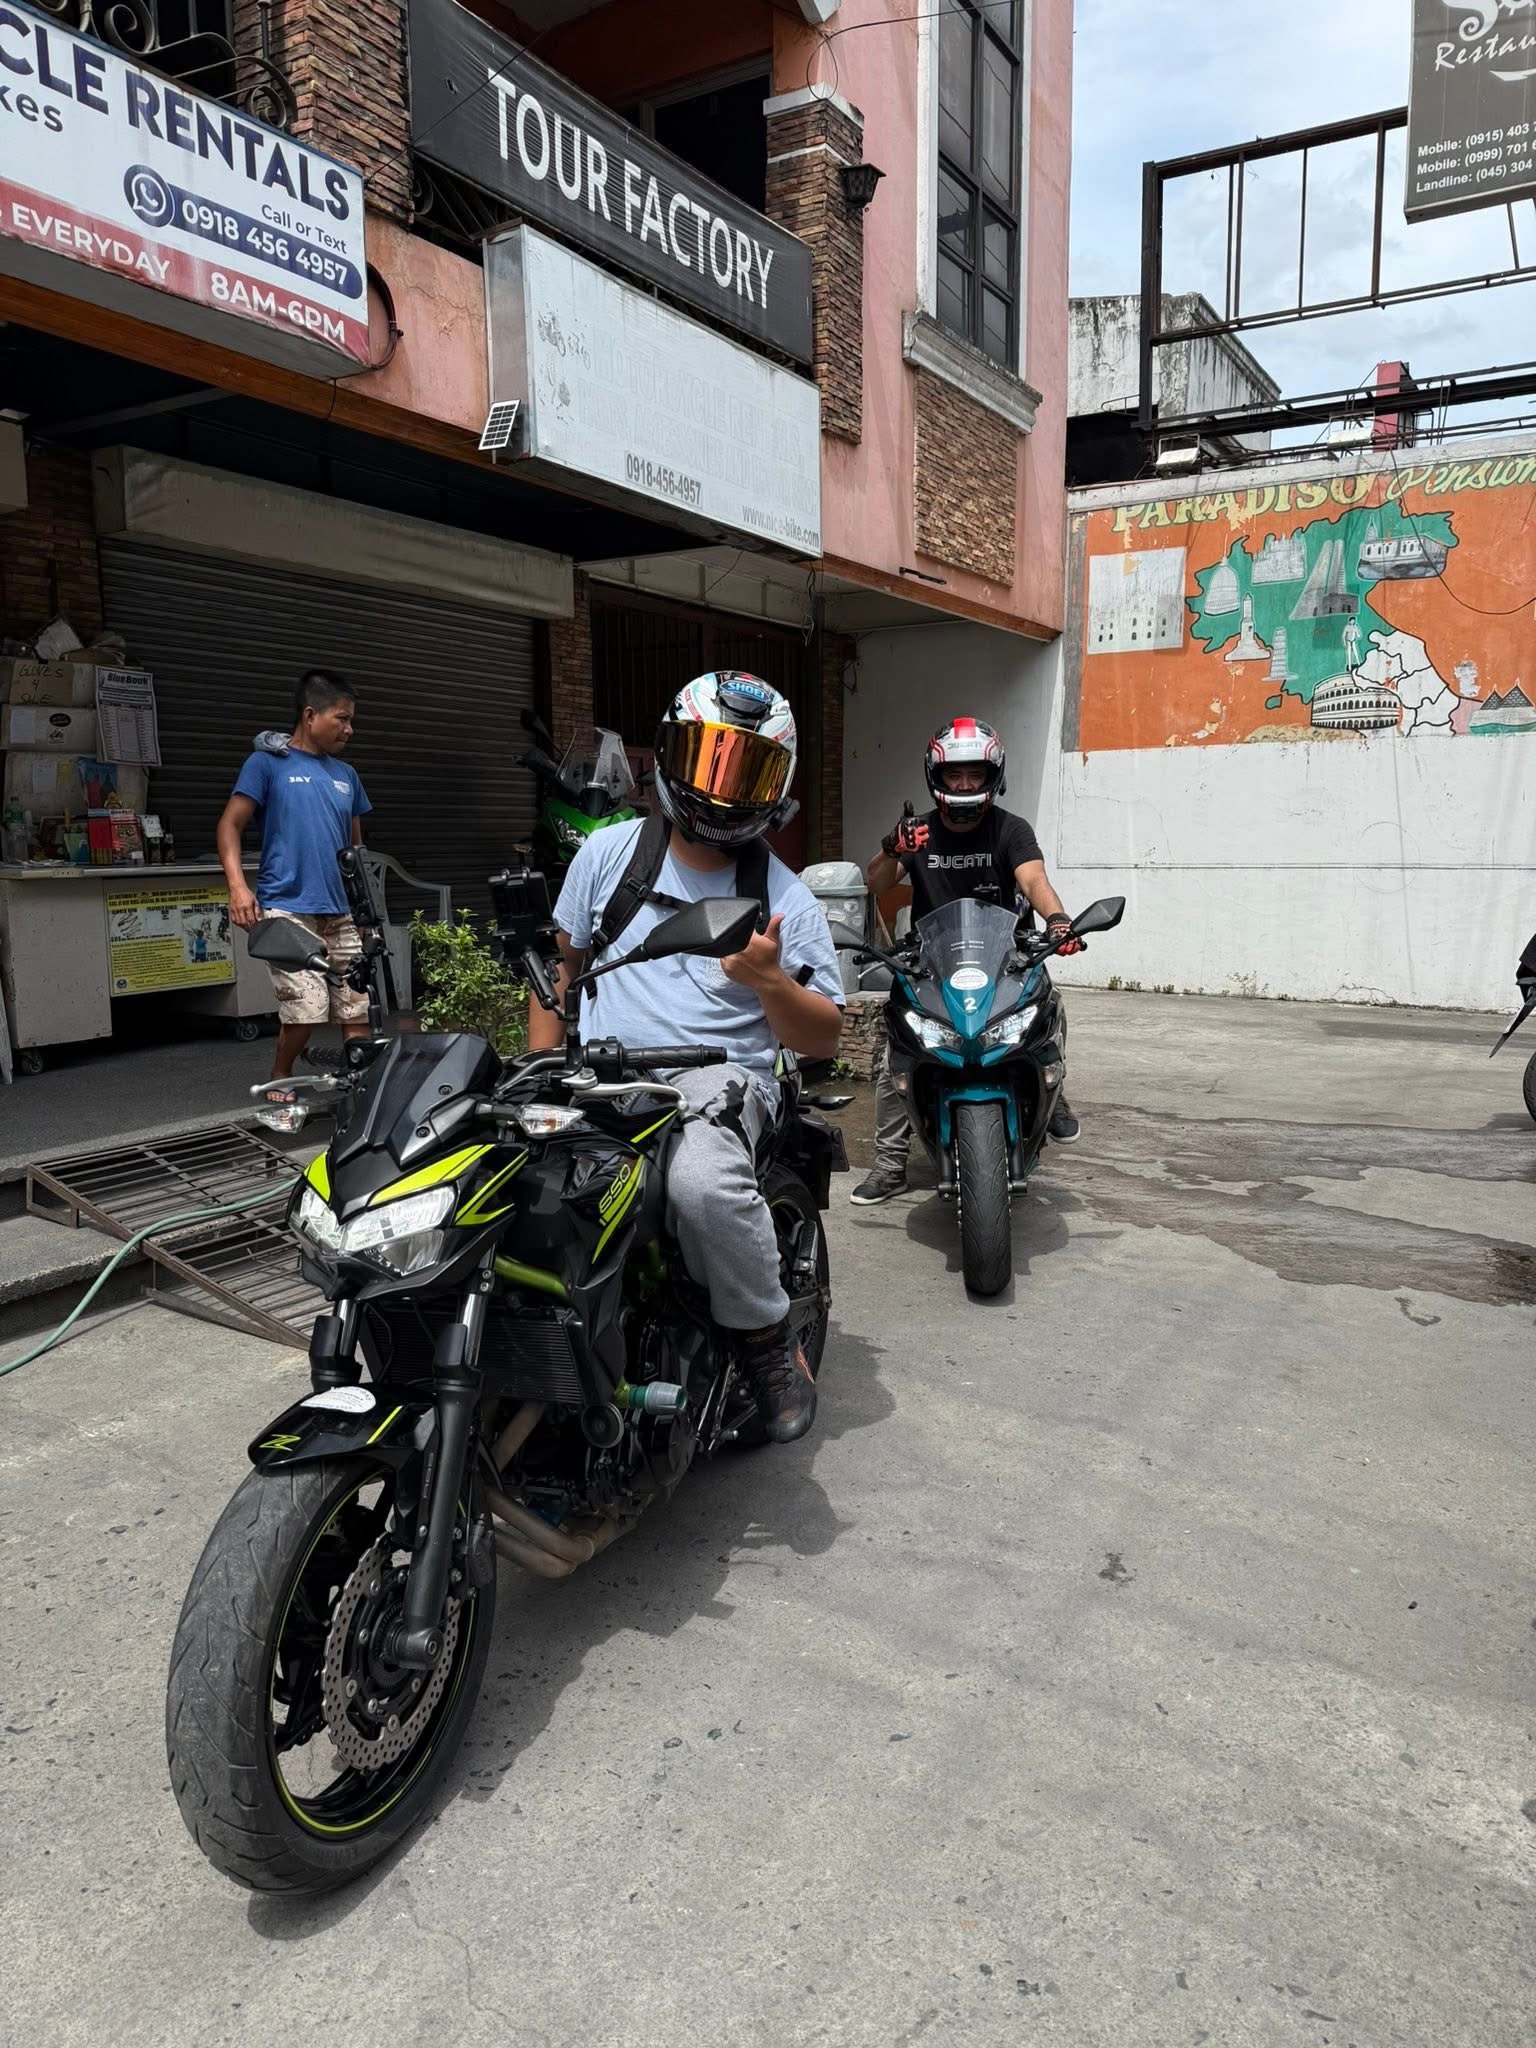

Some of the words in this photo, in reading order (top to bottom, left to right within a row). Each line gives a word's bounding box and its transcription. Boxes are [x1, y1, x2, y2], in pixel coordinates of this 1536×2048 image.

[125, 69, 350, 221] RENTALS
[1417, 140, 1462, 157] Mobile:
[1465, 128, 1504, 149] (0915)
[1506, 123, 1530, 137] 403
[1417, 158, 1461, 175] Mobile:
[1464, 147, 1503, 167] (0999)
[1506, 141, 1528, 156] 701
[487, 67, 612, 222] TOUR
[624, 159, 774, 309] FACTORY
[1416, 173, 1472, 192] Landline:
[1476, 164, 1507, 183] (045)
[1510, 159, 1533, 173] 304
[12, 202, 170, 280] EVERYDAY
[182, 199, 240, 241] 0918
[246, 226, 290, 261] 456
[295, 247, 348, 285] 4957
[261, 204, 291, 229] Call
[295, 221, 312, 237] or
[315, 227, 347, 254] Text
[211, 271, 345, 344] 8AM-6PM
[626, 453, 702, 505] 0918-456-4957
[1111, 472, 1378, 532] PARADISO
[742, 504, 820, 547] www.nice-bike.com
[727, 682, 765, 699] SHOEI
[947, 741, 982, 750] DUCATI
[927, 853, 992, 869] DUCATI
[964, 997, 978, 1011] 2
[599, 1163, 631, 1214] 650
